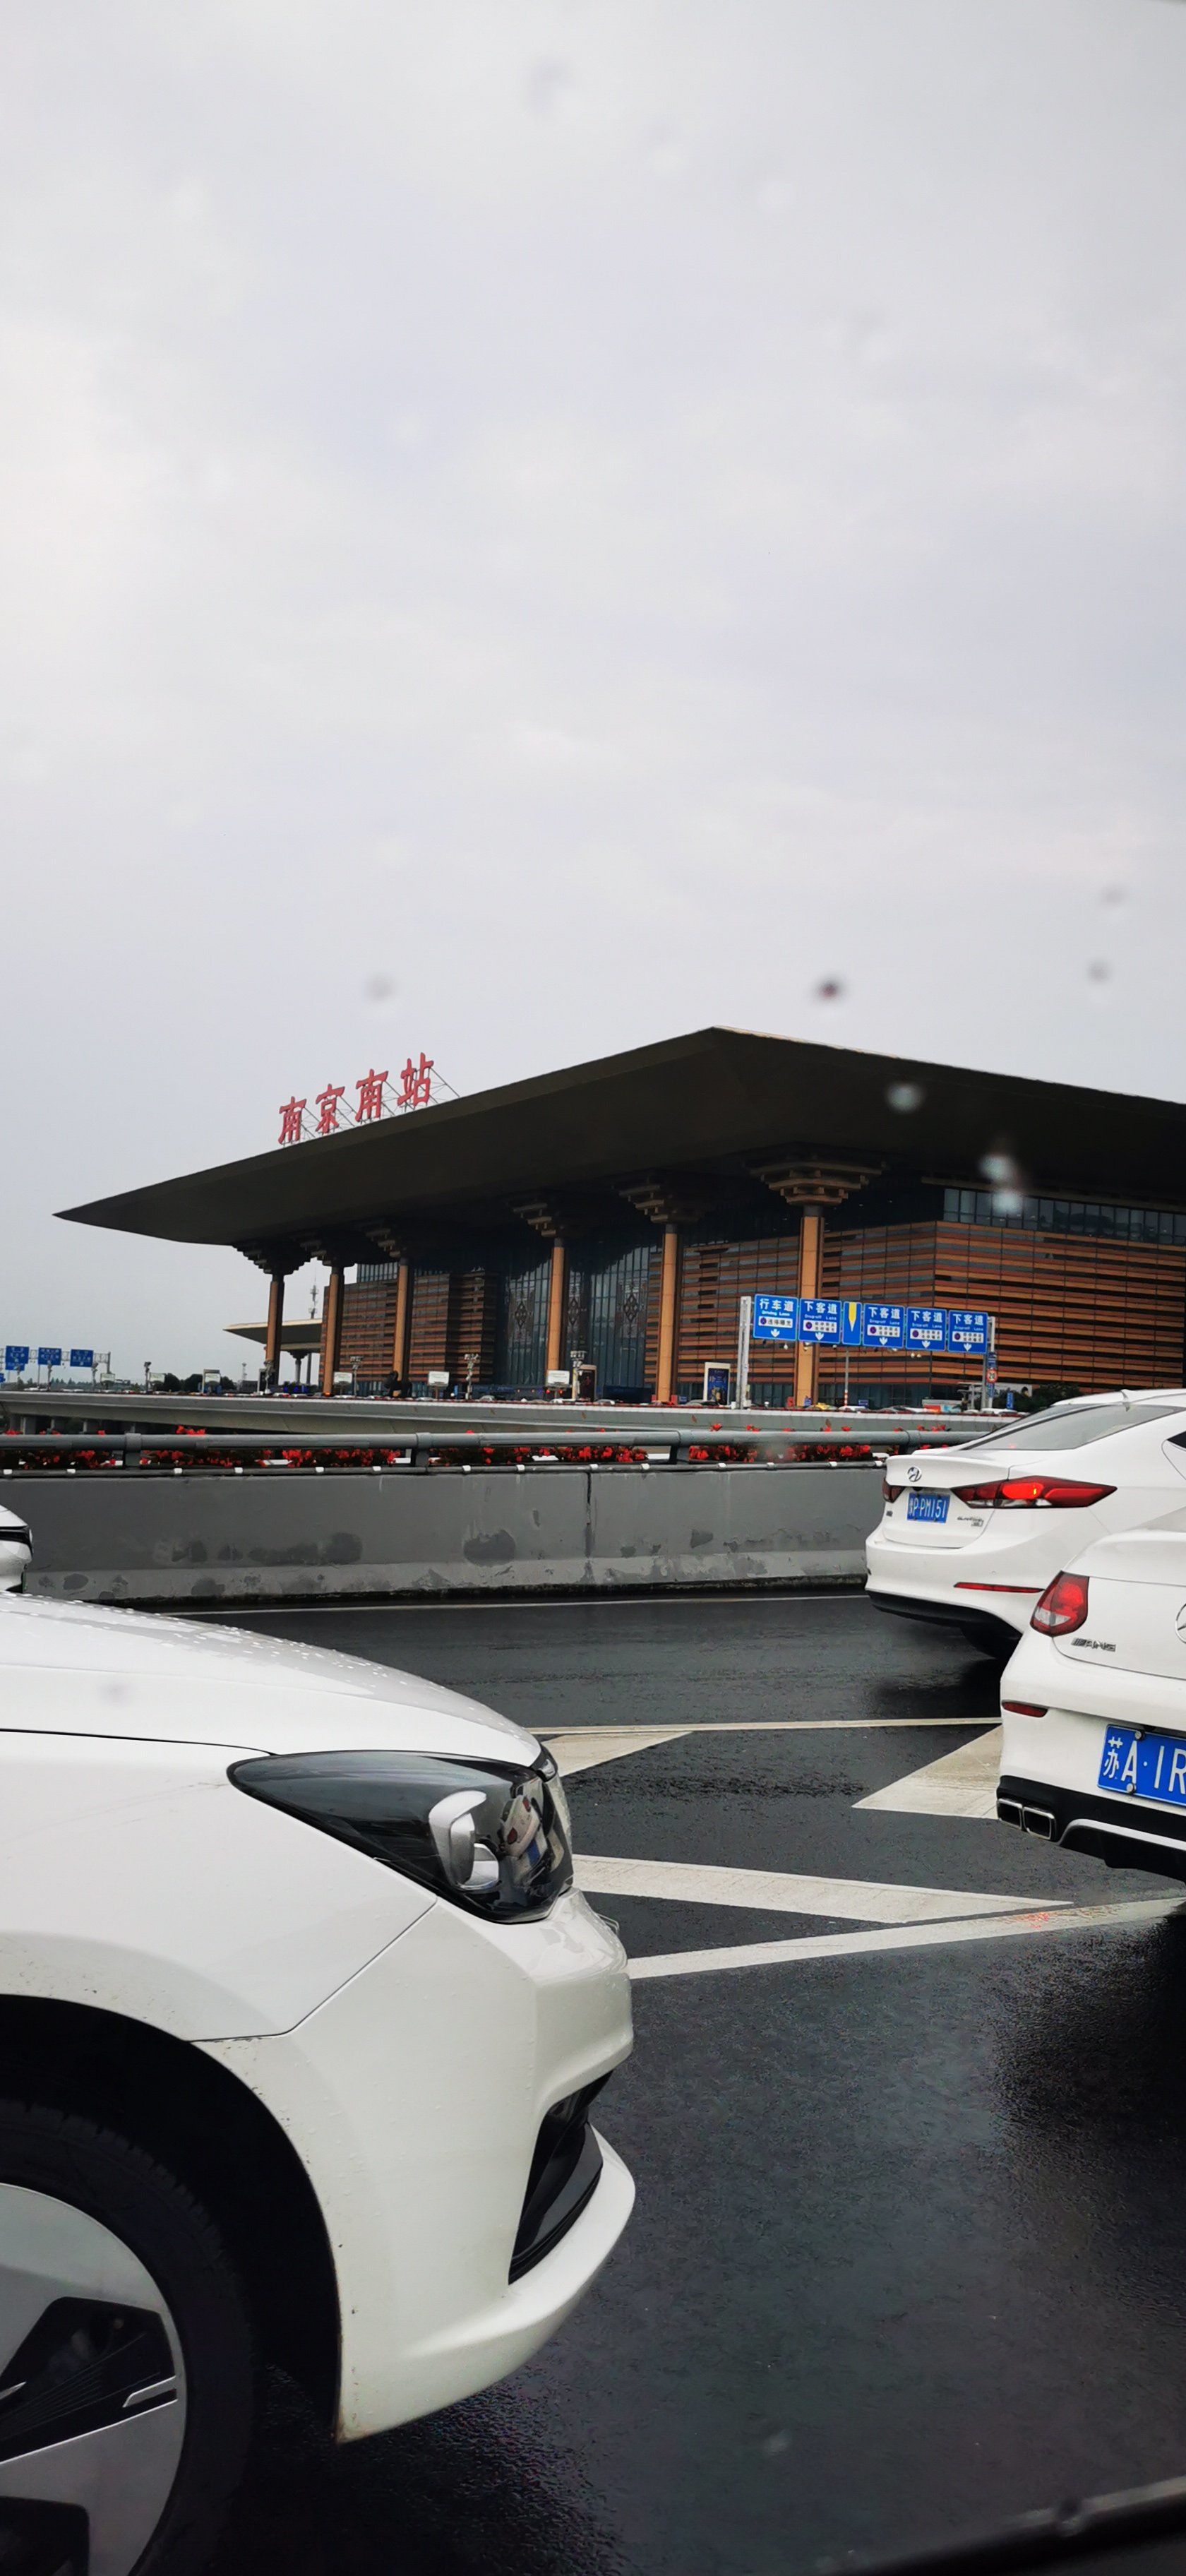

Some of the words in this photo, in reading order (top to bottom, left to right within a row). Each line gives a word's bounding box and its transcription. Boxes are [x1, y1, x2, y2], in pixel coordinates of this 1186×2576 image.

[277, 1052, 434, 1145] 南京南站
[760, 1298, 793, 1312] 行车道
[804, 1301, 837, 1314] 下客道
[868, 1306, 900, 1320] 下客道
[911, 1310, 942, 1323] 下客道
[952, 1313, 983, 1325] 下客道
